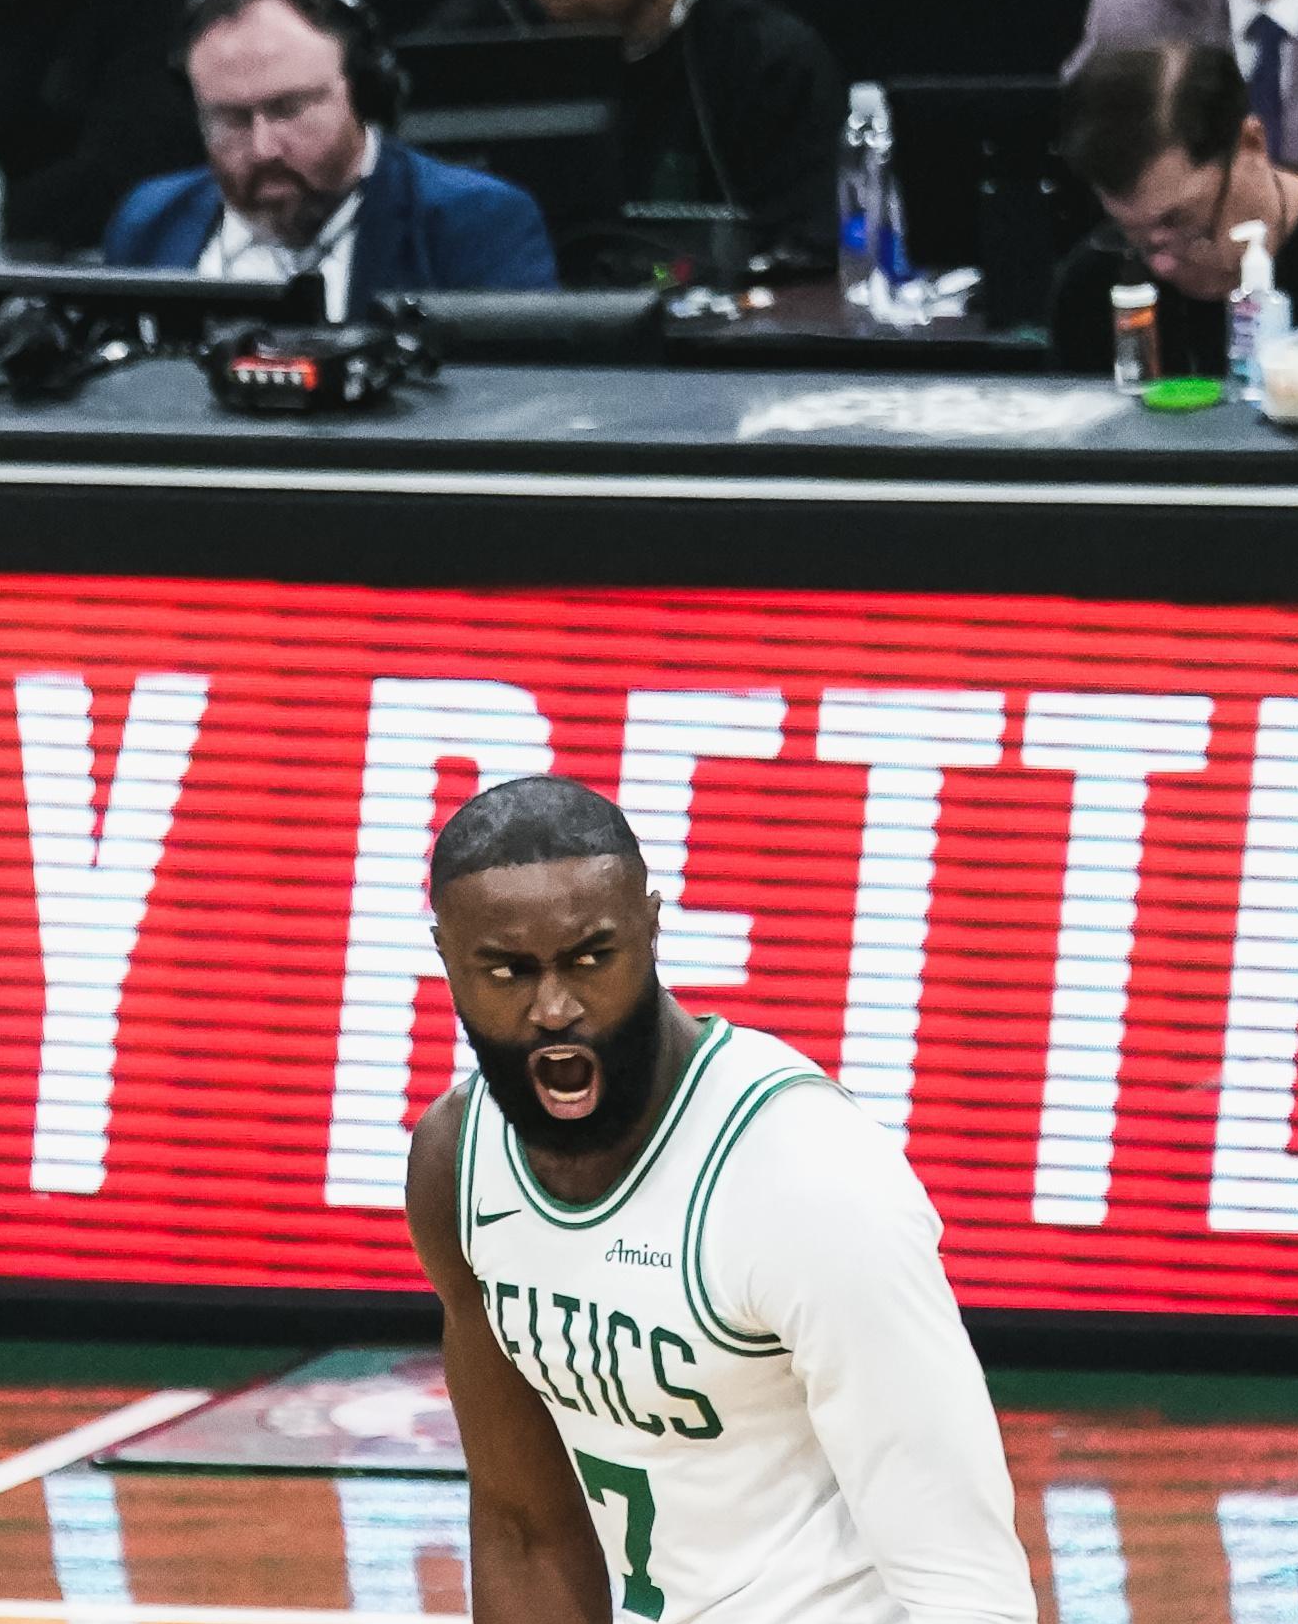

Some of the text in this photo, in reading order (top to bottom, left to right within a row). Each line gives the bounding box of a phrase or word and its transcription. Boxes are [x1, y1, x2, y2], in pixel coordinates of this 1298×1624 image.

[604, 1238, 673, 1269] Amica
[478, 1279, 725, 1440] ELTICS
[573, 1447, 666, 1623] 7
